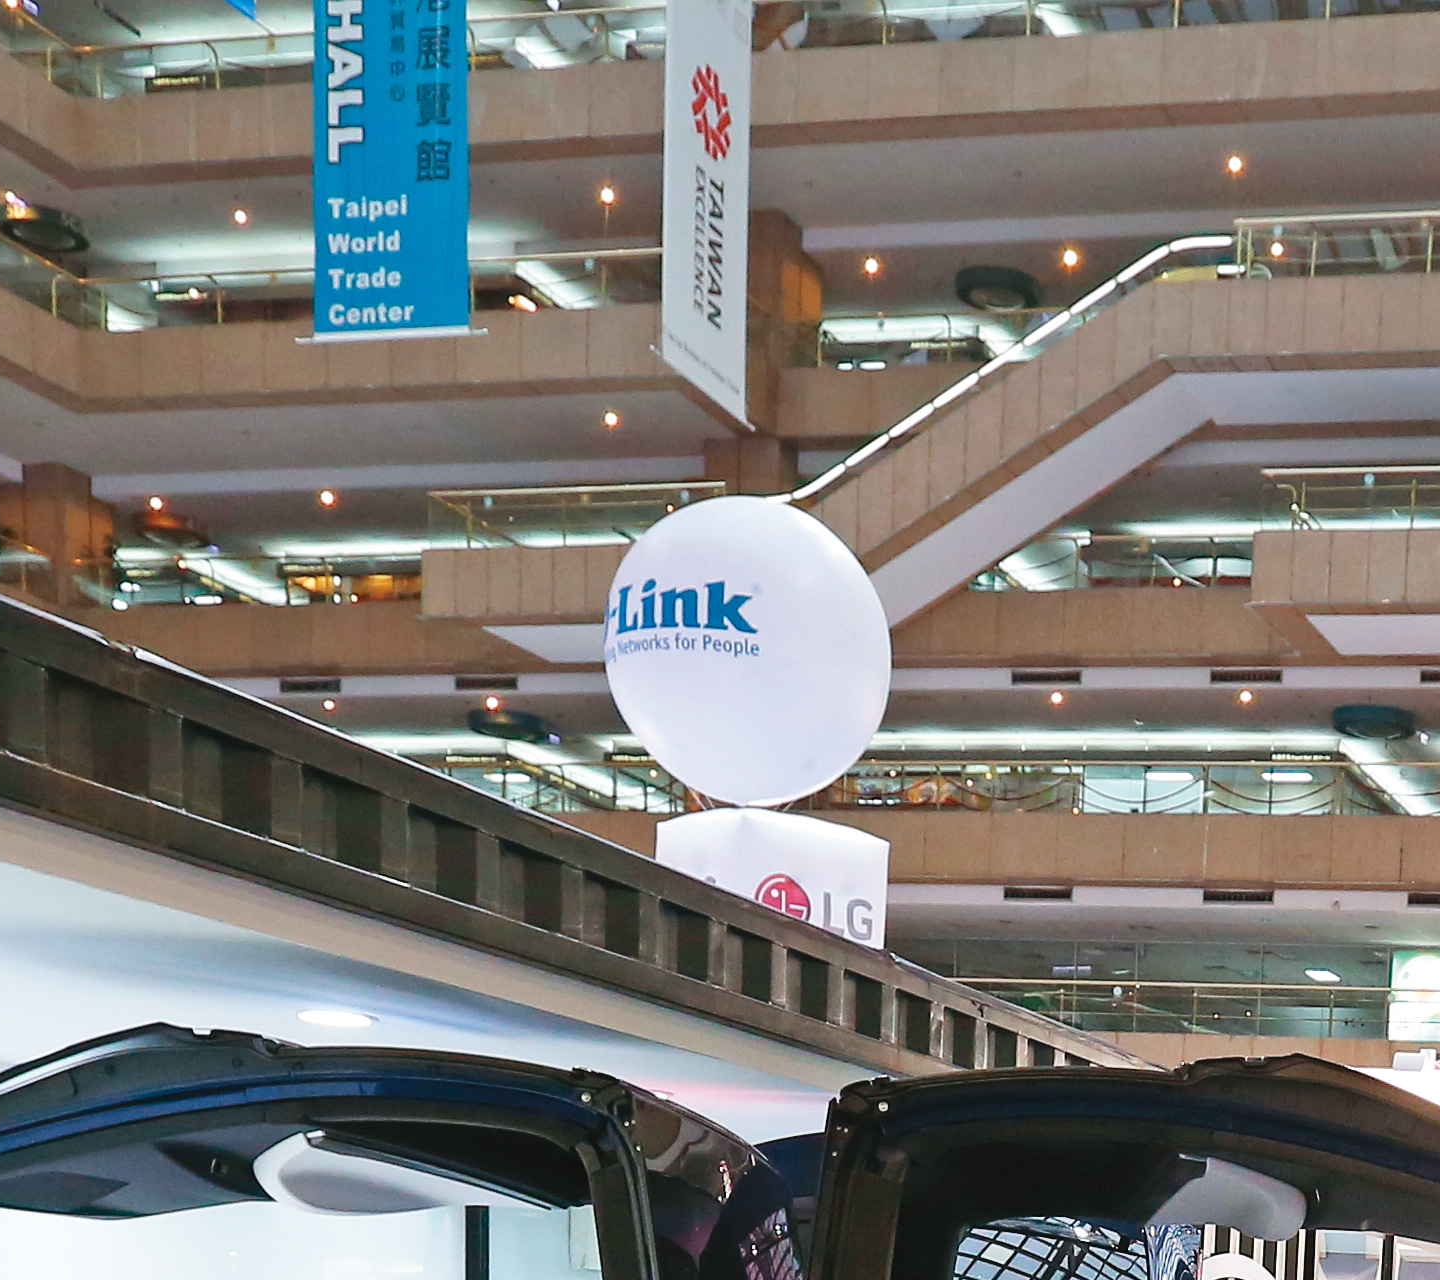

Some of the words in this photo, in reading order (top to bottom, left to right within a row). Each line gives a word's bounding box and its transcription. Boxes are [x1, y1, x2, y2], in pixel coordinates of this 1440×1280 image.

[327, 0, 364, 163] HALL
[327, 194, 408, 222] Taipei
[328, 230, 401, 254] World
[693, 164, 706, 316] EXCELLENCE
[707, 179, 725, 331] TAIWAN
[328, 266, 403, 289] Trade
[329, 303, 416, 325] Center
[605, 578, 758, 635] -Link
[674, 632, 698, 650] for
[703, 634, 760, 658] People
[822, 890, 874, 941] LG
